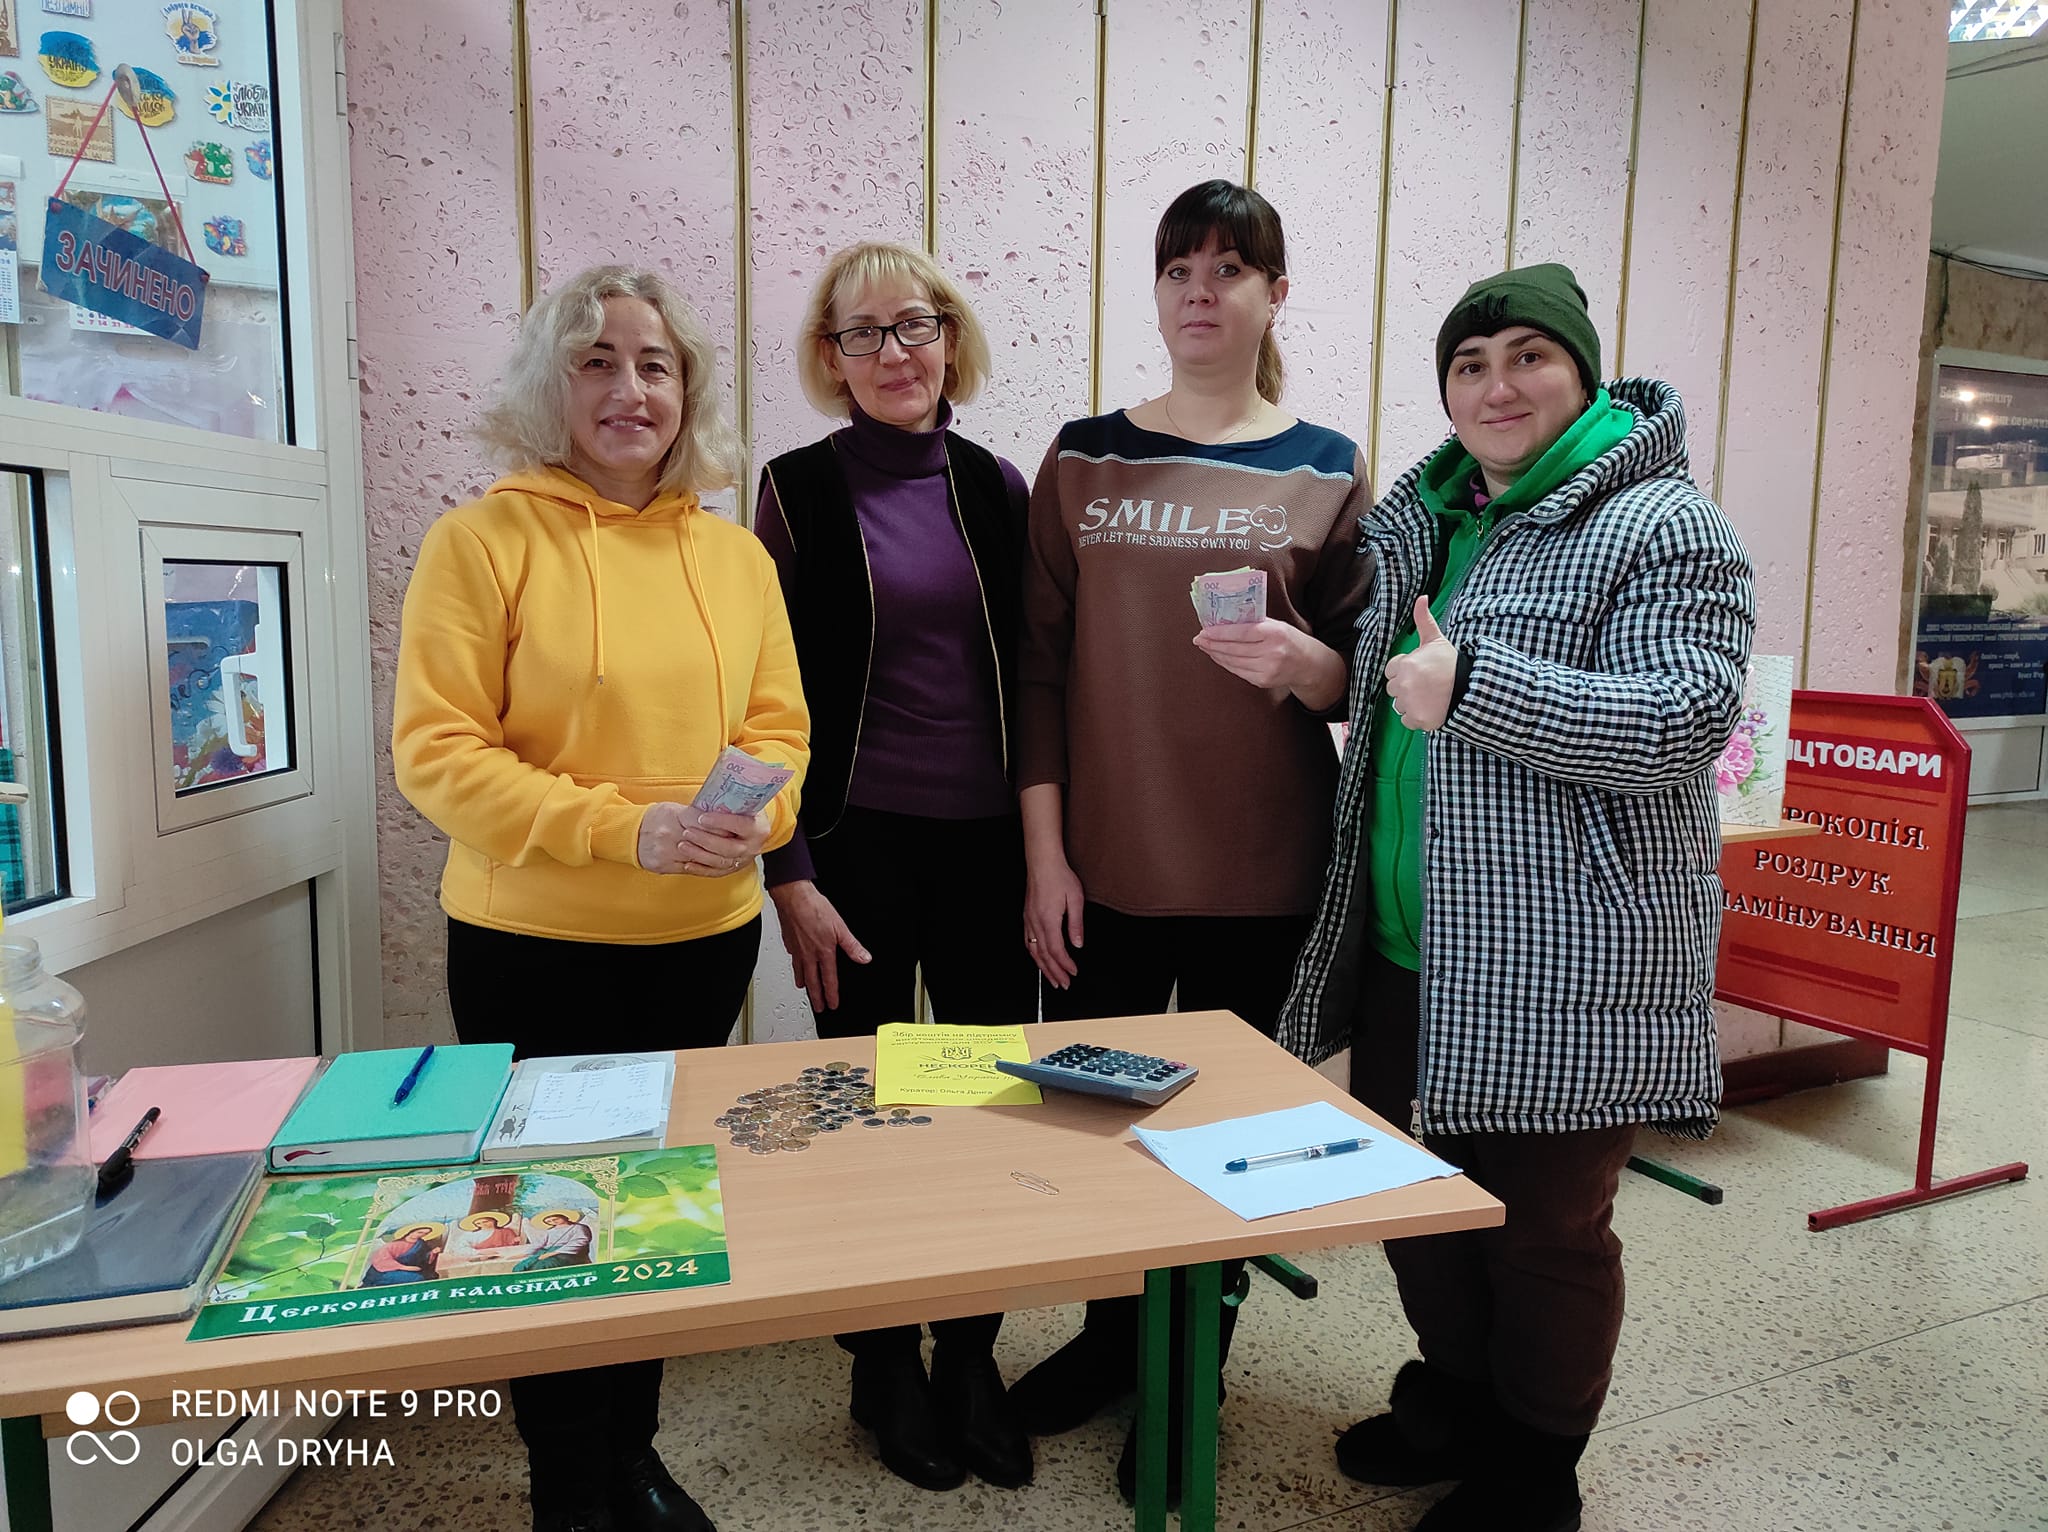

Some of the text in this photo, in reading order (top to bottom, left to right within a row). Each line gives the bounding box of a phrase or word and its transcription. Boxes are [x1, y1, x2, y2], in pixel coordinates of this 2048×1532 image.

[56, 231, 195, 321] ЗАЧИНЕНО
[1078, 498, 1251, 536] SMILE
[1078, 532, 1251, 550] NEVER LET THE SADNESS OWN YOU
[1782, 806, 1930, 851] РОКОПІЯ.
[1753, 848, 1895, 896] РОЗДРУК.
[611, 1259, 699, 1284] 2024
